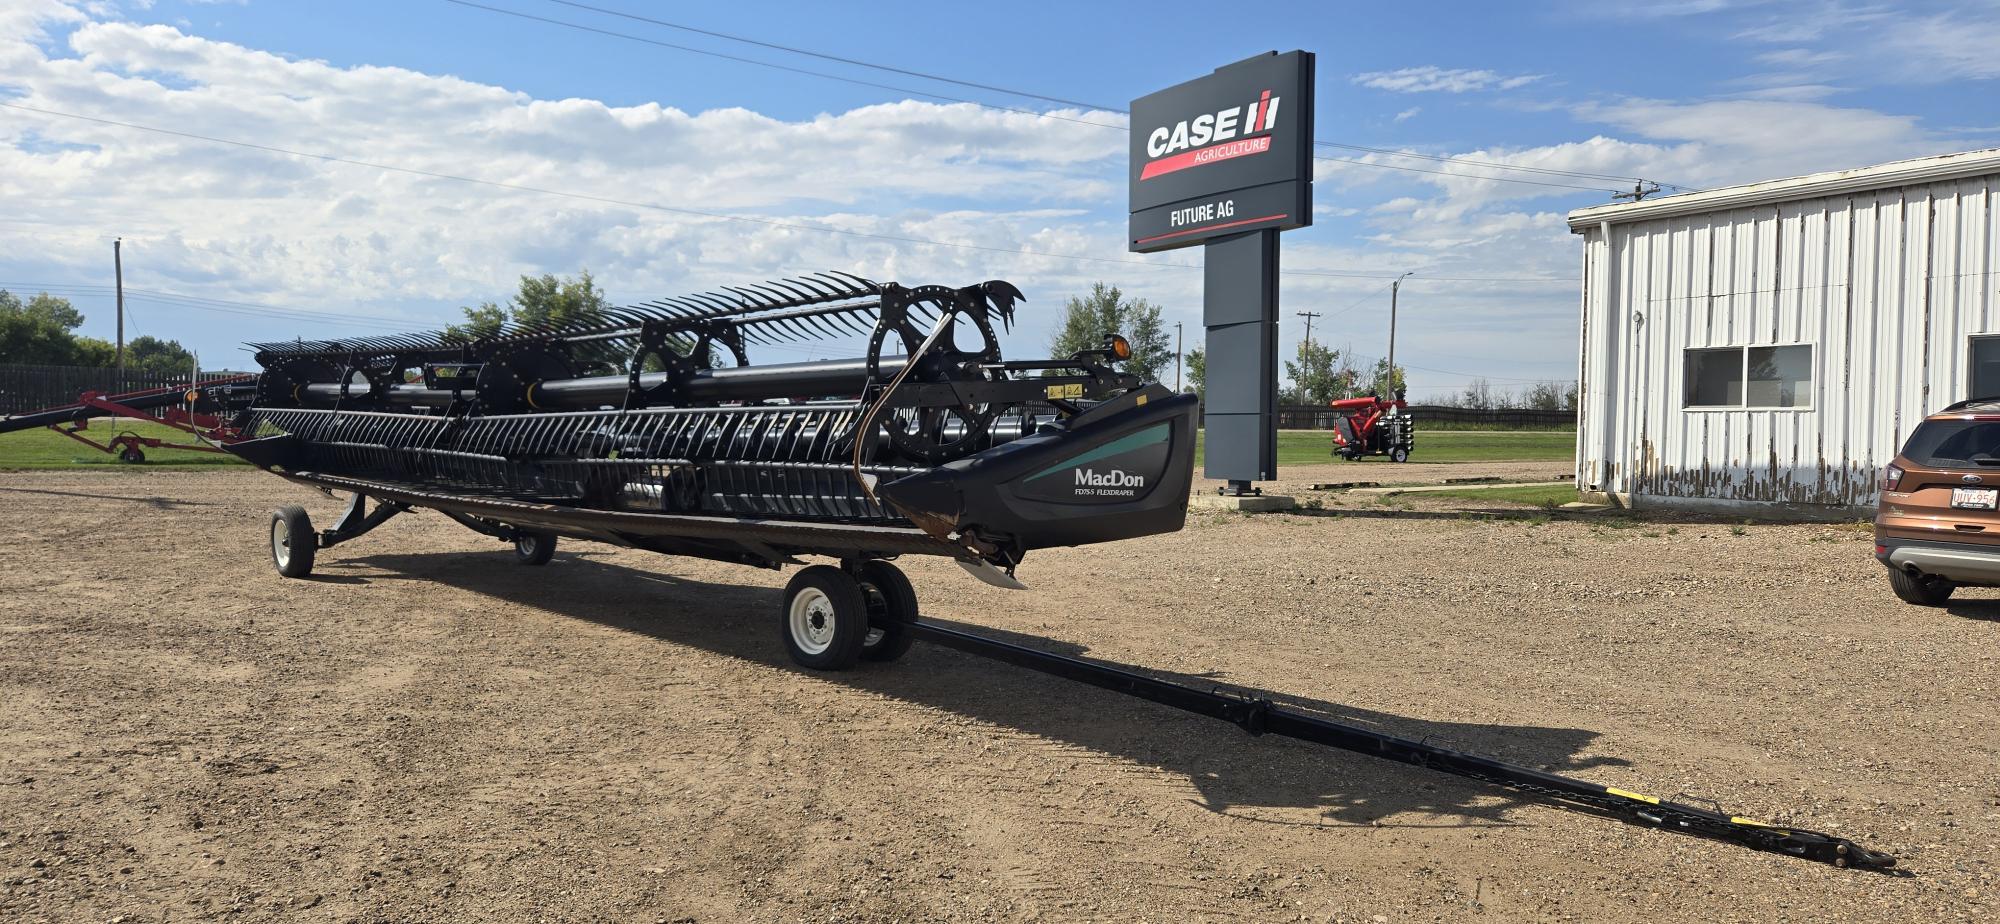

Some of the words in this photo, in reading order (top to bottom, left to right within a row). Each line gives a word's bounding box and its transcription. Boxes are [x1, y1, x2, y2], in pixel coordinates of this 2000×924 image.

[1147, 106, 1241, 158] CASE
[1194, 137, 1267, 163] AGRICULTURE
[1171, 204, 1213, 227] FUTURE
[1217, 200, 1234, 219] AG
[1075, 468, 1144, 487] MacDon
